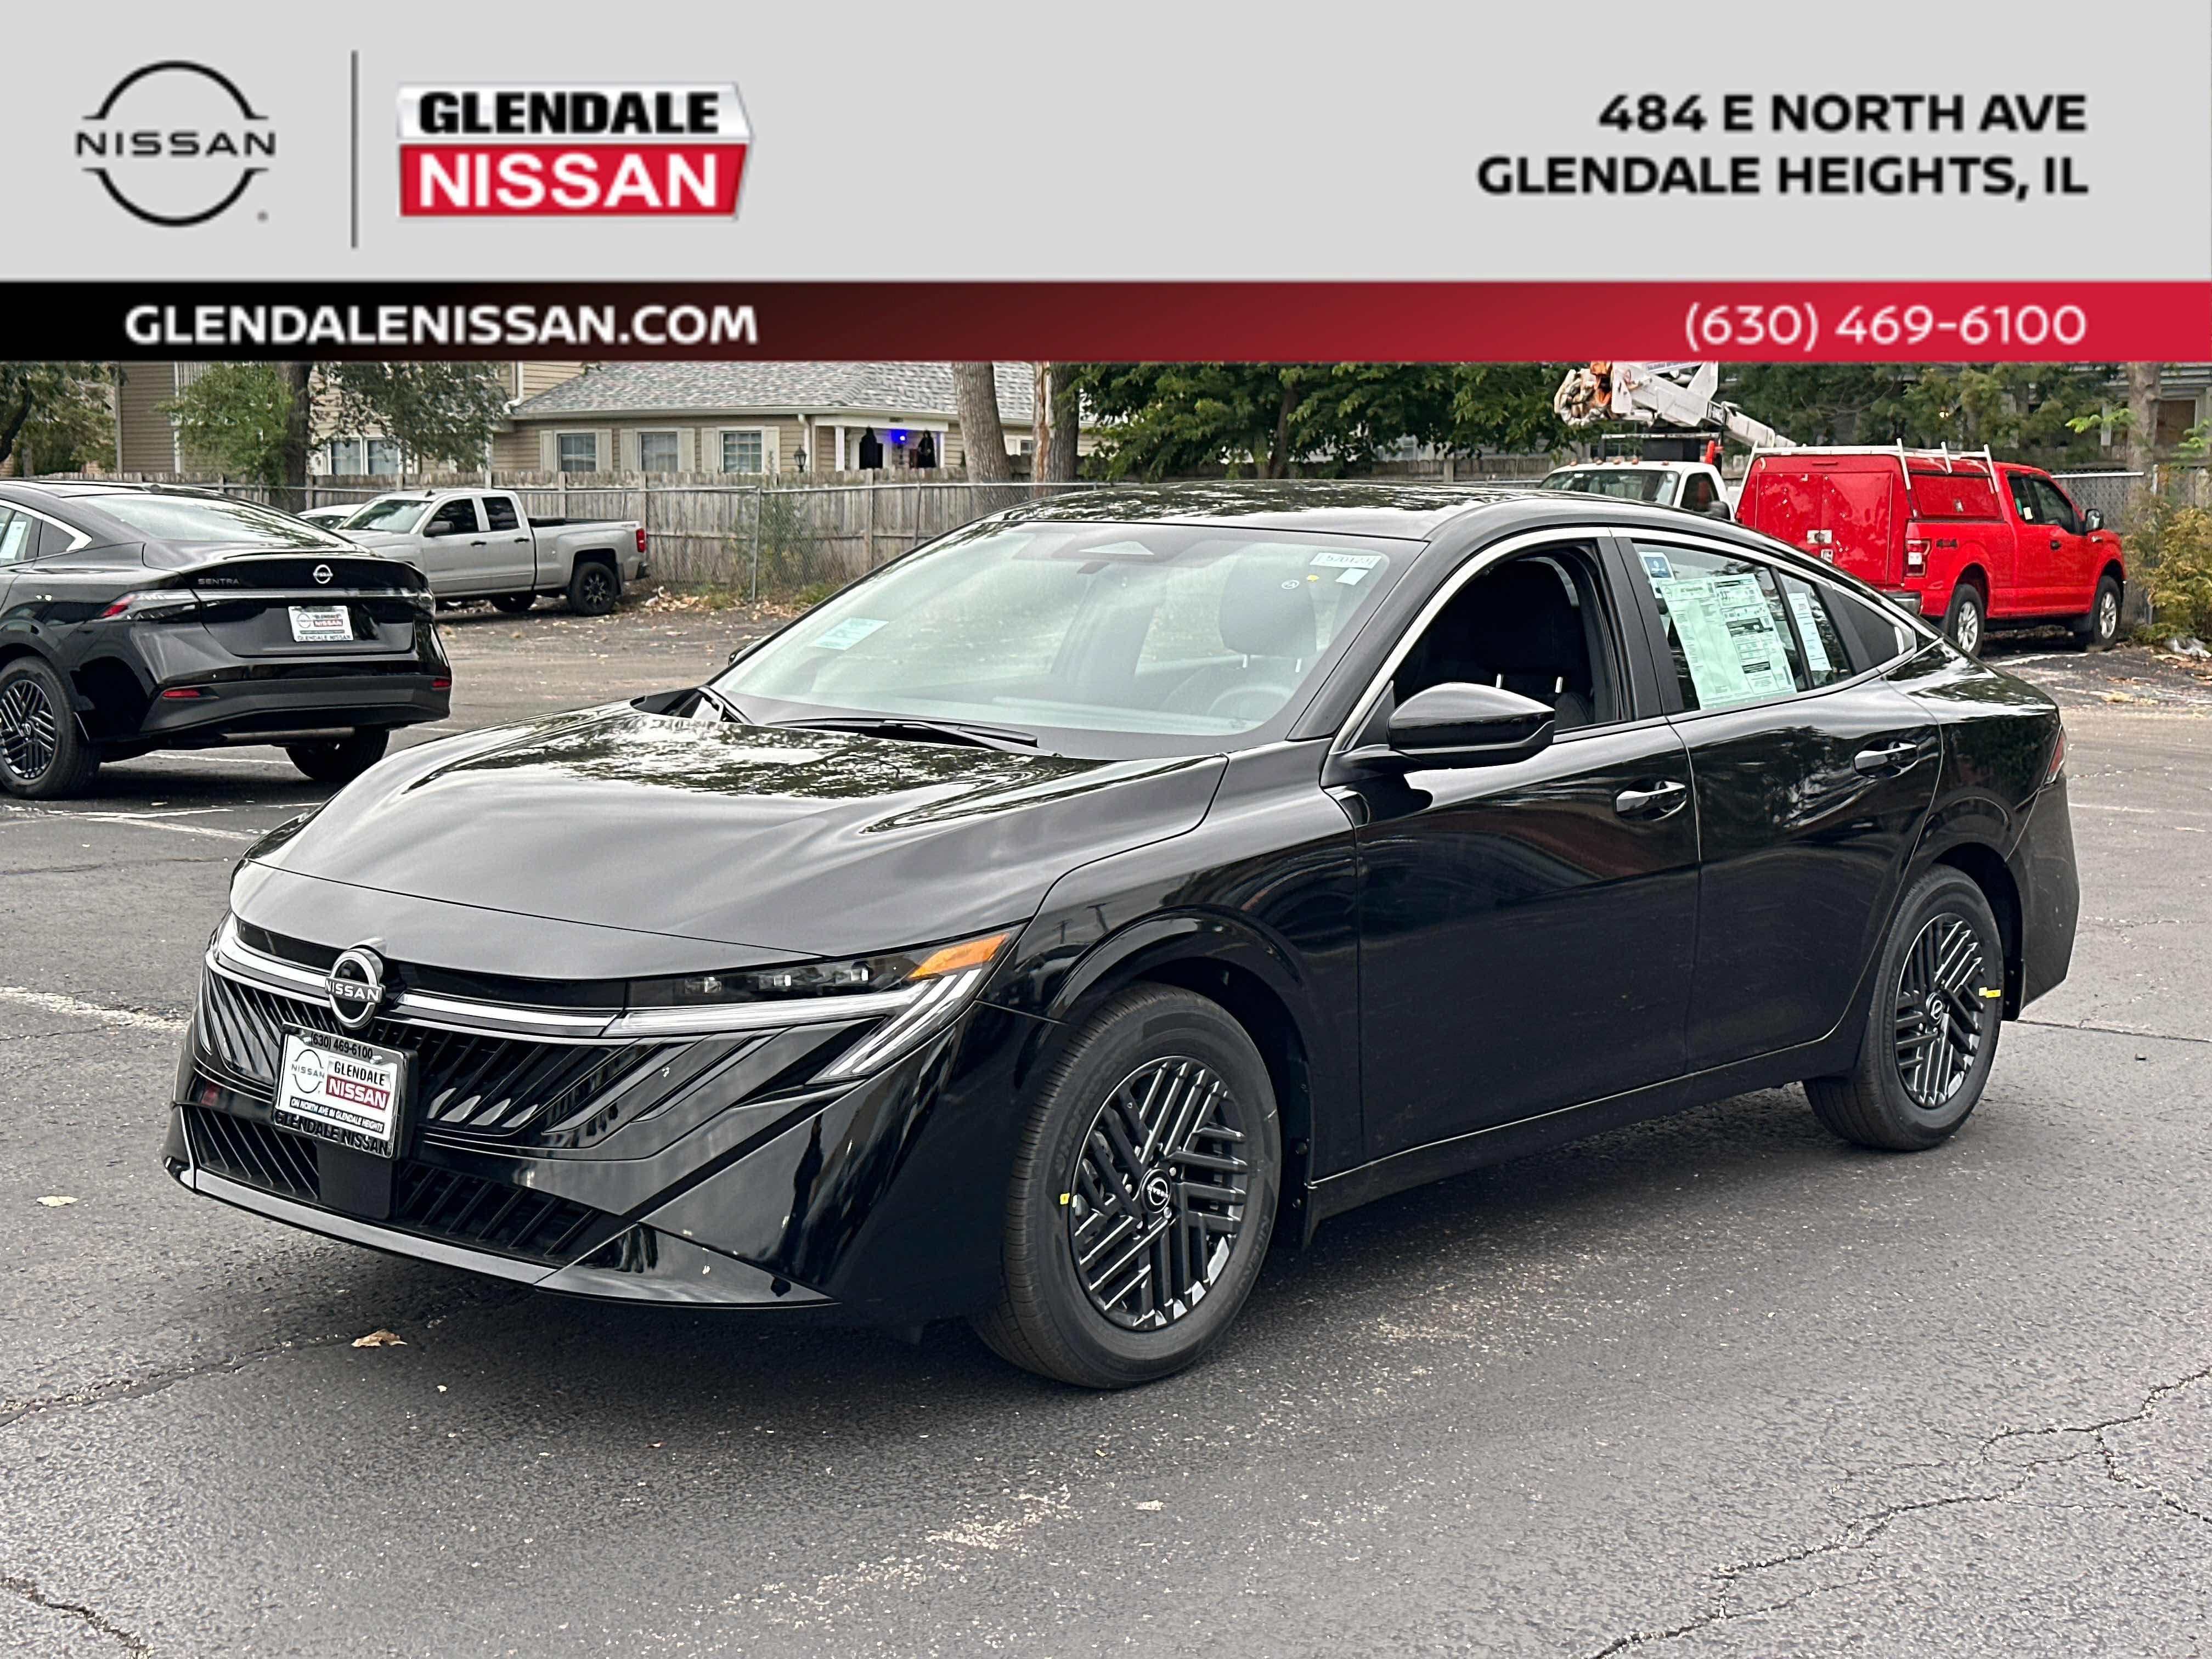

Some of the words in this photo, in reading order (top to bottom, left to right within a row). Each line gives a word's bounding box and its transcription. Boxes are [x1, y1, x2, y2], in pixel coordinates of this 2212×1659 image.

[325, 978, 379, 1001] NISSAN
[311, 1031, 331, 1050] (630)
[333, 1038, 373, 1059] 469-6100
[291, 1064, 325, 1079] NISSAN
[334, 1061, 386, 1086] GLENDALE
[329, 1077, 387, 1109] NISSAN
[291, 1098, 299, 1107] ON
[300, 1101, 318, 1112] NORTH
[318, 1105, 329, 1116] AVE
[335, 1110, 362, 1125] GLENDALE
[362, 1118, 383, 1132] HEIGHTS
[275, 1110, 340, 1141] GLENDALE
[342, 1129, 388, 1156] NISSAN
